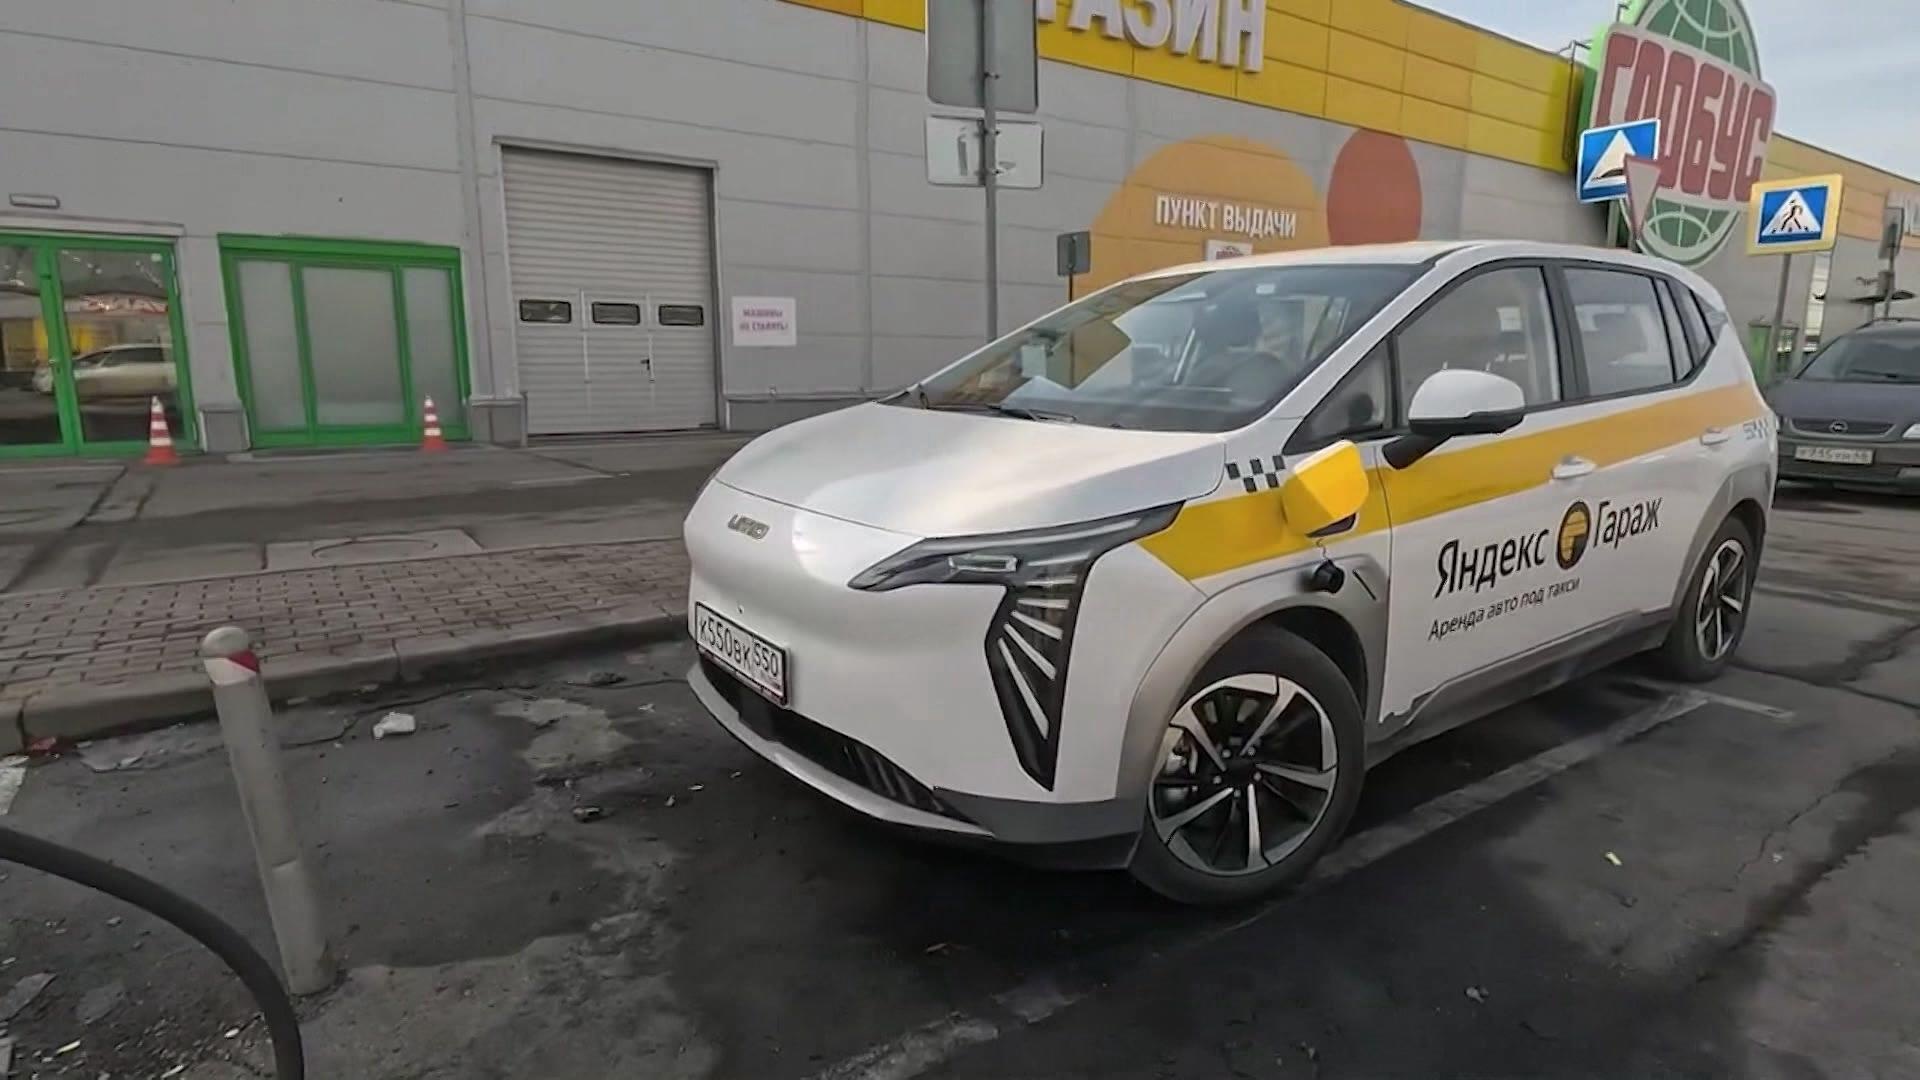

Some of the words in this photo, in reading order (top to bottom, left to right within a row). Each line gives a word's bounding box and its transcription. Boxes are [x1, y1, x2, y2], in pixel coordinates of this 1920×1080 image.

[1596, 32, 1774, 203] ГЛОБУС
[1156, 195, 1219, 230] ПУНКТ
[1223, 204, 1297, 238] ВЫДАЧИ
[1434, 529, 1550, 598] Яндекс
[1593, 497, 1663, 549] Гараж
[1428, 608, 1484, 641] Аренда
[1487, 599, 1518, 621] авто
[1520, 587, 1545, 606] под
[1547, 577, 1580, 599] такси
